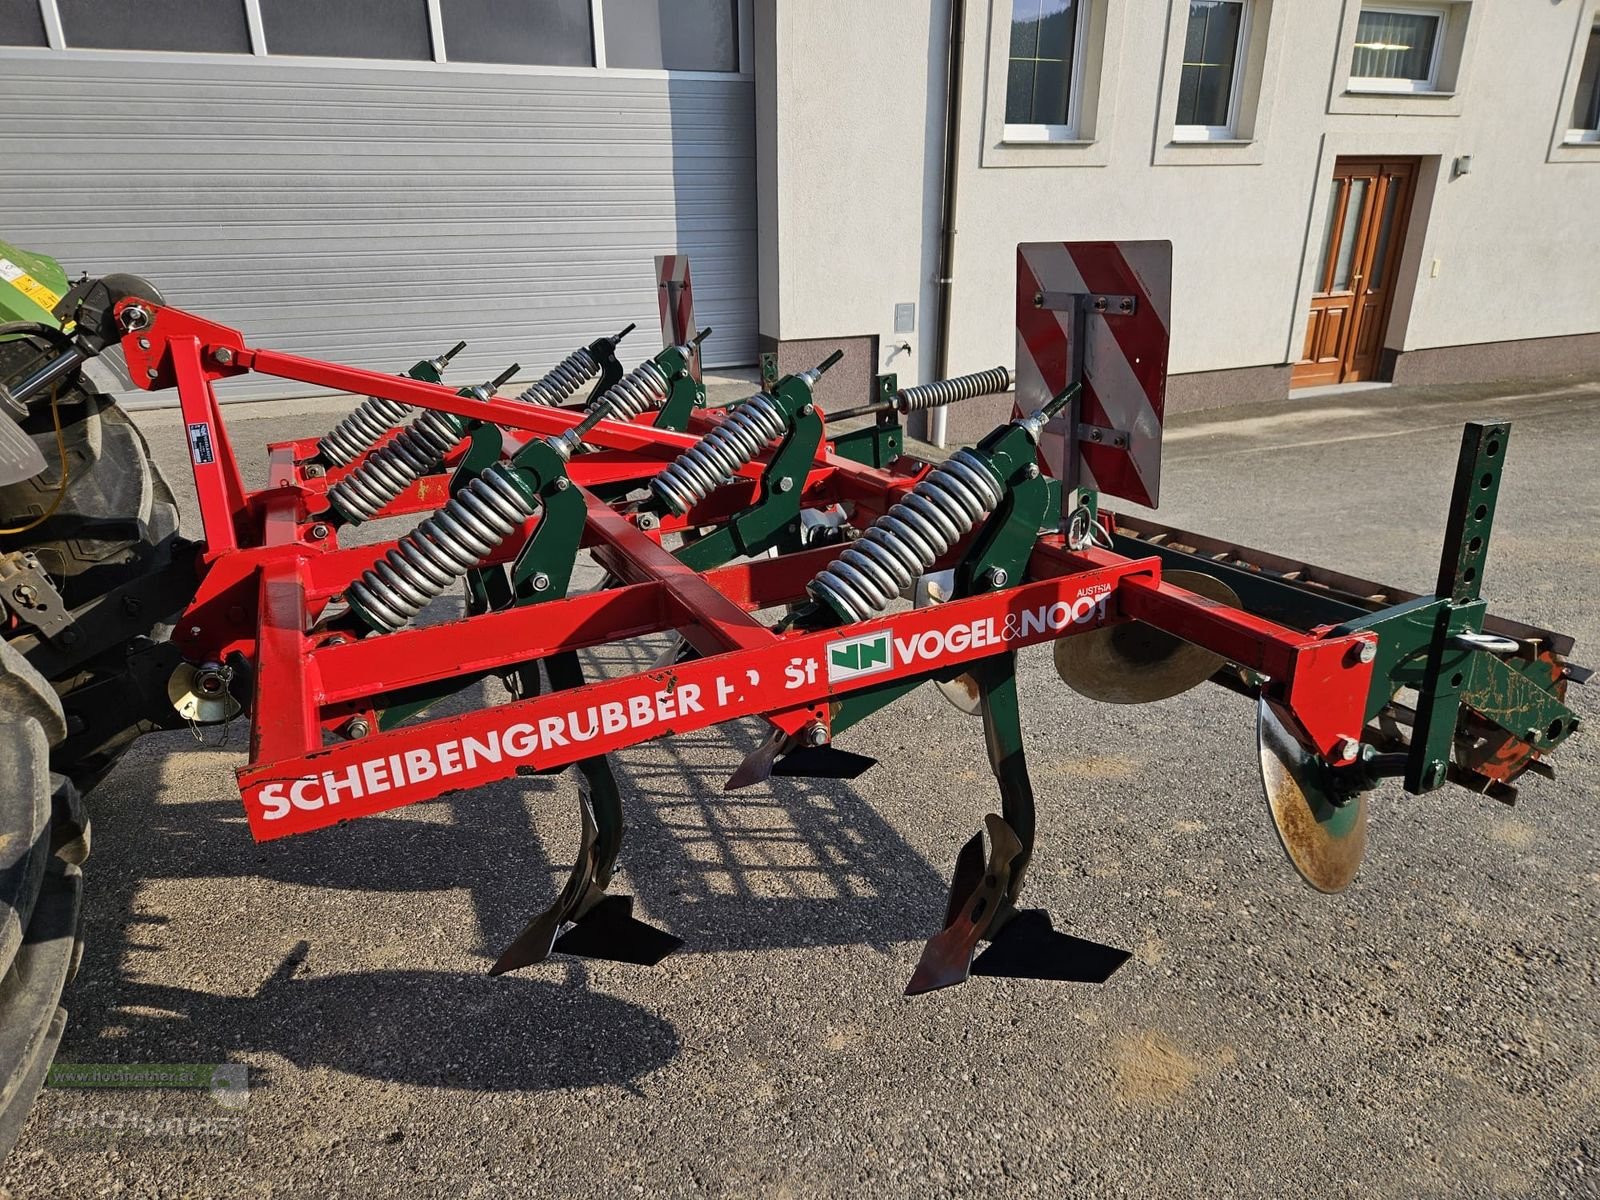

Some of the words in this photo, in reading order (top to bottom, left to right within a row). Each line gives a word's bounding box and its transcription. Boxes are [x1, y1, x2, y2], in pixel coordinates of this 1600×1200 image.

[1077, 583, 1112, 598] AUSTRIA
[258, 682, 704, 822] SCHEIBENGRUBBER
[784, 657, 819, 689] St
